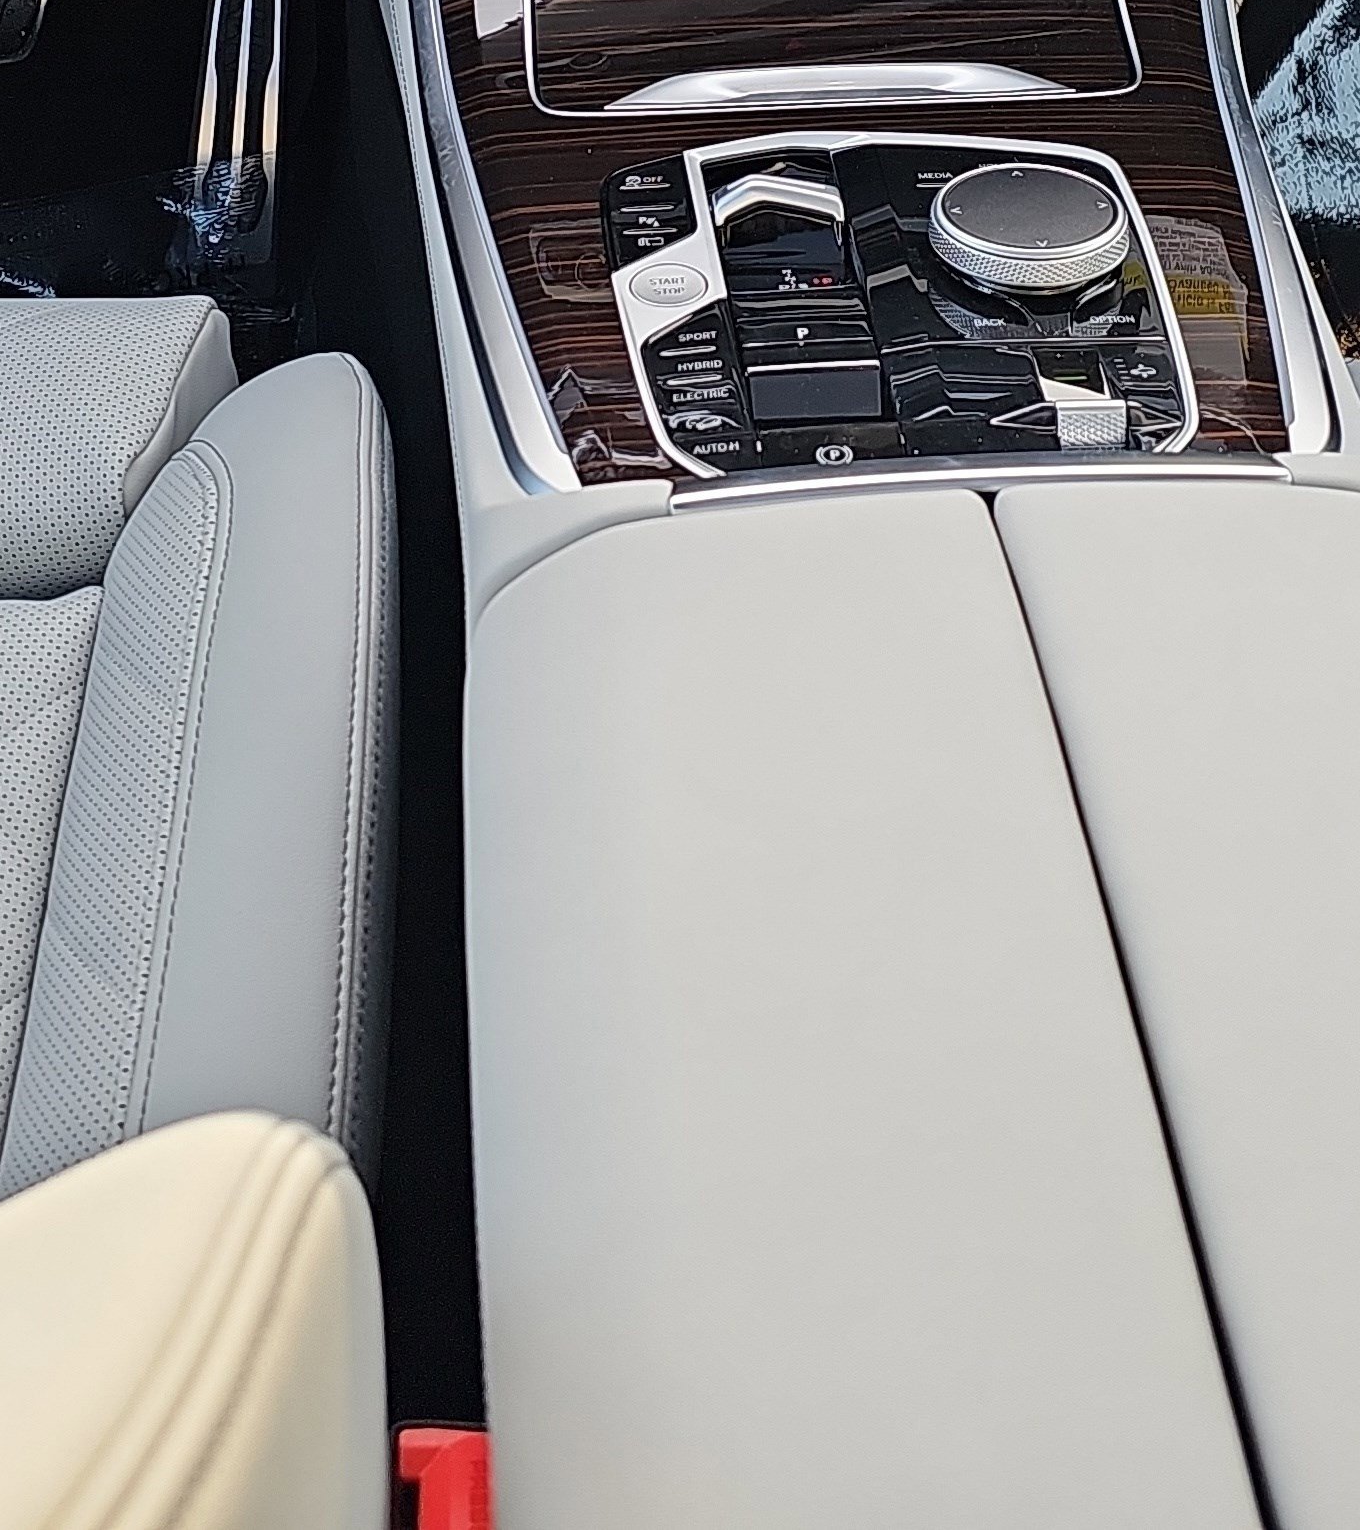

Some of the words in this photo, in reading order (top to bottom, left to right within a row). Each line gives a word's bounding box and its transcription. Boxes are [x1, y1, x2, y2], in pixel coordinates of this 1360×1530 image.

[642, 176, 664, 184] OFF
[649, 276, 685, 286] START
[653, 286, 685, 295] STOP
[973, 317, 1007, 327] BACK
[1089, 315, 1136, 324] OPTION
[678, 330, 718, 343] SPORT
[796, 327, 809, 339] P
[677, 359, 723, 371] HYBRID
[672, 387, 730, 402] ELECTRIC
[693, 442, 728, 455] AUTO
[729, 440, 740, 451] H
